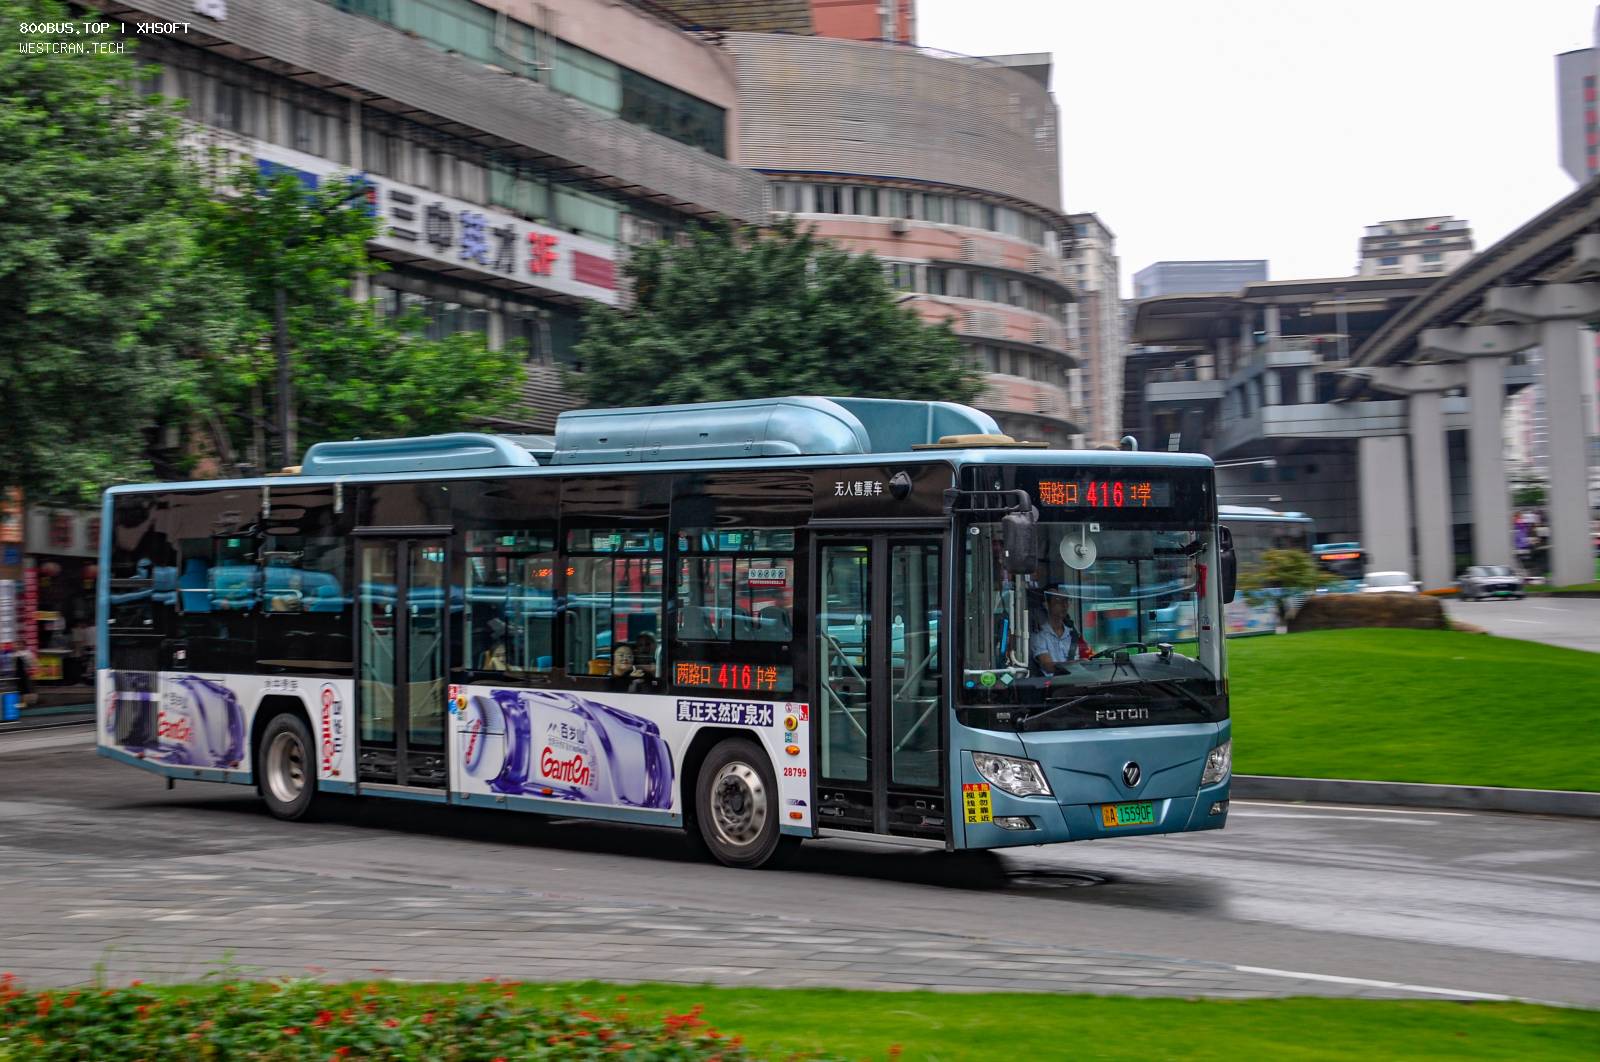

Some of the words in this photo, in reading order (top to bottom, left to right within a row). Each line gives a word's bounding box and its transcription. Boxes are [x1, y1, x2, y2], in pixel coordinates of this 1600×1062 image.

[834, 481, 883, 497] 无人售票车
[1039, 481, 1079, 504] 两路口
[1086, 481, 1125, 507] 416
[677, 663, 711, 686] 两路口
[718, 664, 752, 689] 416
[678, 701, 773, 726] 真正天然矿泉水
[1095, 708, 1149, 721] FOTON
[541, 747, 591, 786] Ganten
[783, 767, 807, 777] 28799
[1104, 807, 1116, 822] A
[1119, 805, 1151, 822] 15590F
